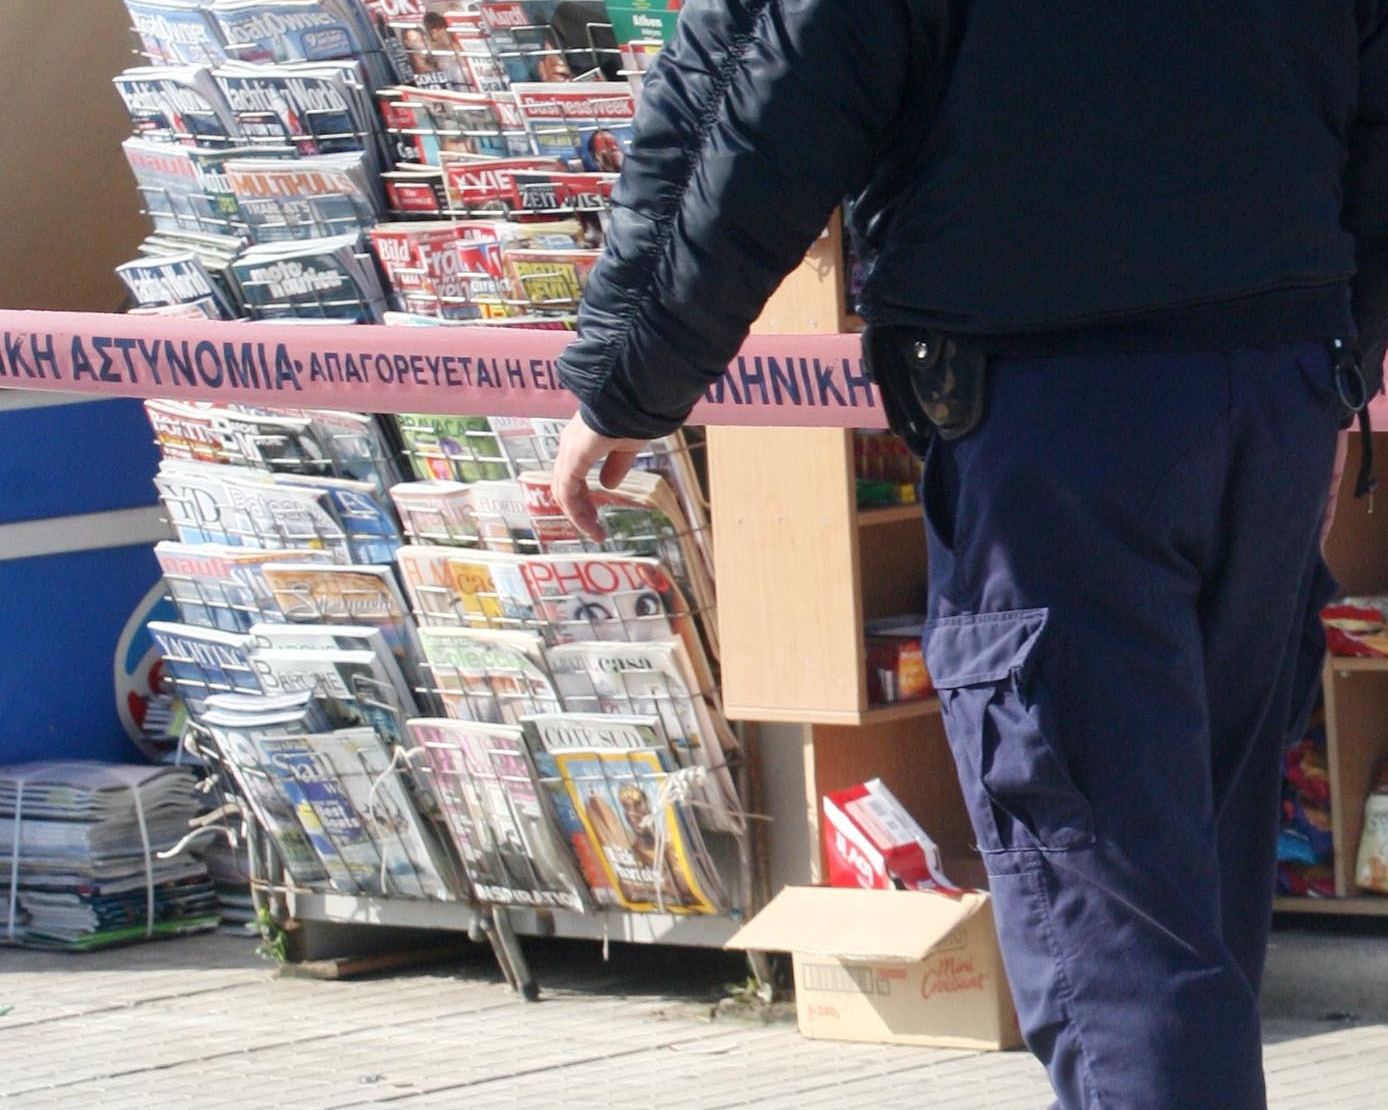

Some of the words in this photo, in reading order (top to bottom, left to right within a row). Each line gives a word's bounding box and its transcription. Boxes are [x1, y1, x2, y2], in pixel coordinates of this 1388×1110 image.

[222, 10, 338, 43] BoatOwner
[527, 94, 634, 117] BusinessWeek
[521, 191, 558, 208] ZEIT
[376, 236, 411, 260] Bild
[72, 333, 301, 392] ΑΣΤΥΝΟΜΙΑ
[309, 350, 505, 390] ΑΠΑΓΟΡΕΥΕΤΑΙ
[507, 357, 527, 389] Η
[703, 356, 874, 409] ΛΗΝΙΚΗ
[528, 560, 671, 596] PHOTO
[156, 634, 250, 666] YACHTING
[597, 656, 653, 673] casa
[255, 659, 344, 690] BARCHE
